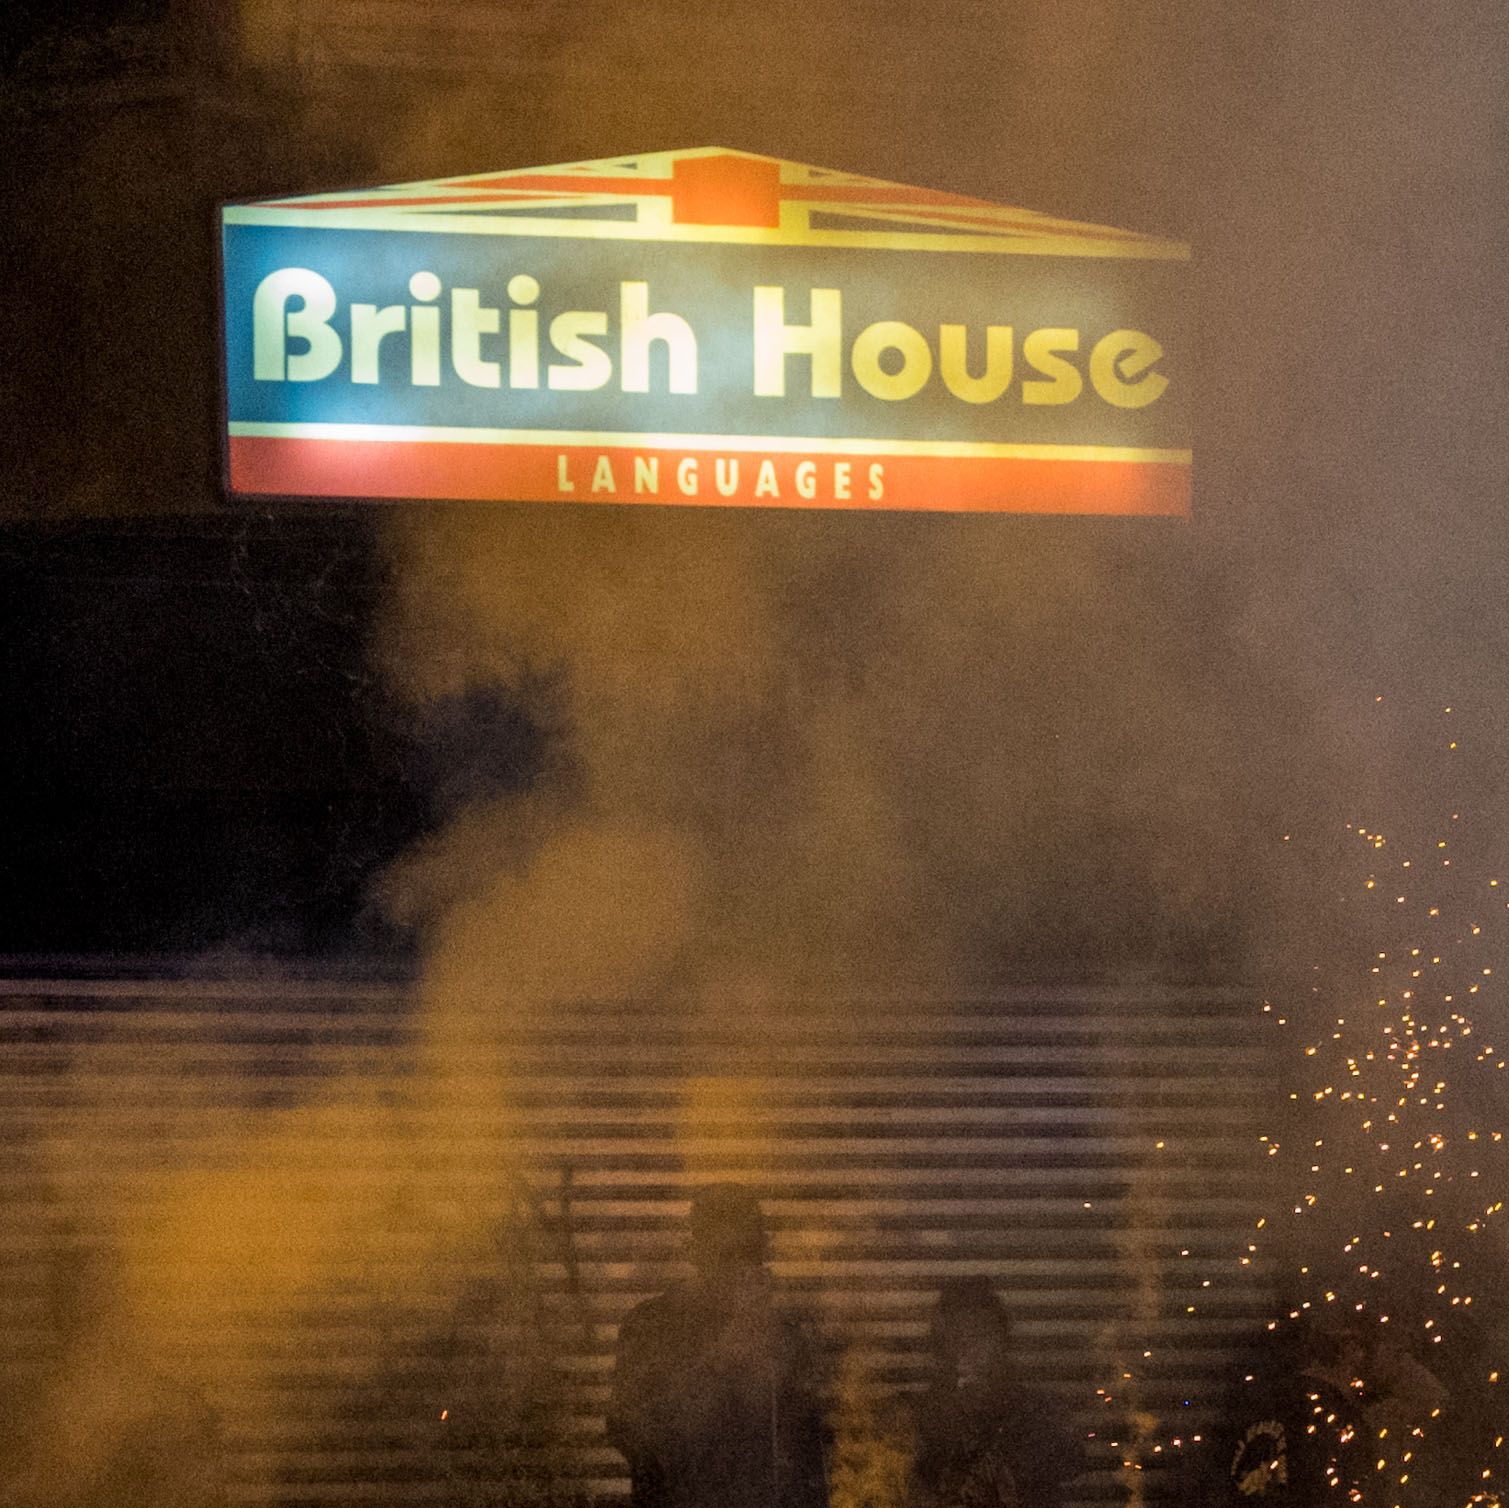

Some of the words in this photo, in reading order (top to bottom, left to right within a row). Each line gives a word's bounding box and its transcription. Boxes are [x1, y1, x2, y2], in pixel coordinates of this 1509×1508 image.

[253, 267, 698, 395] British
[753, 285, 1171, 408] House
[557, 453, 887, 502] LANGUAGES
